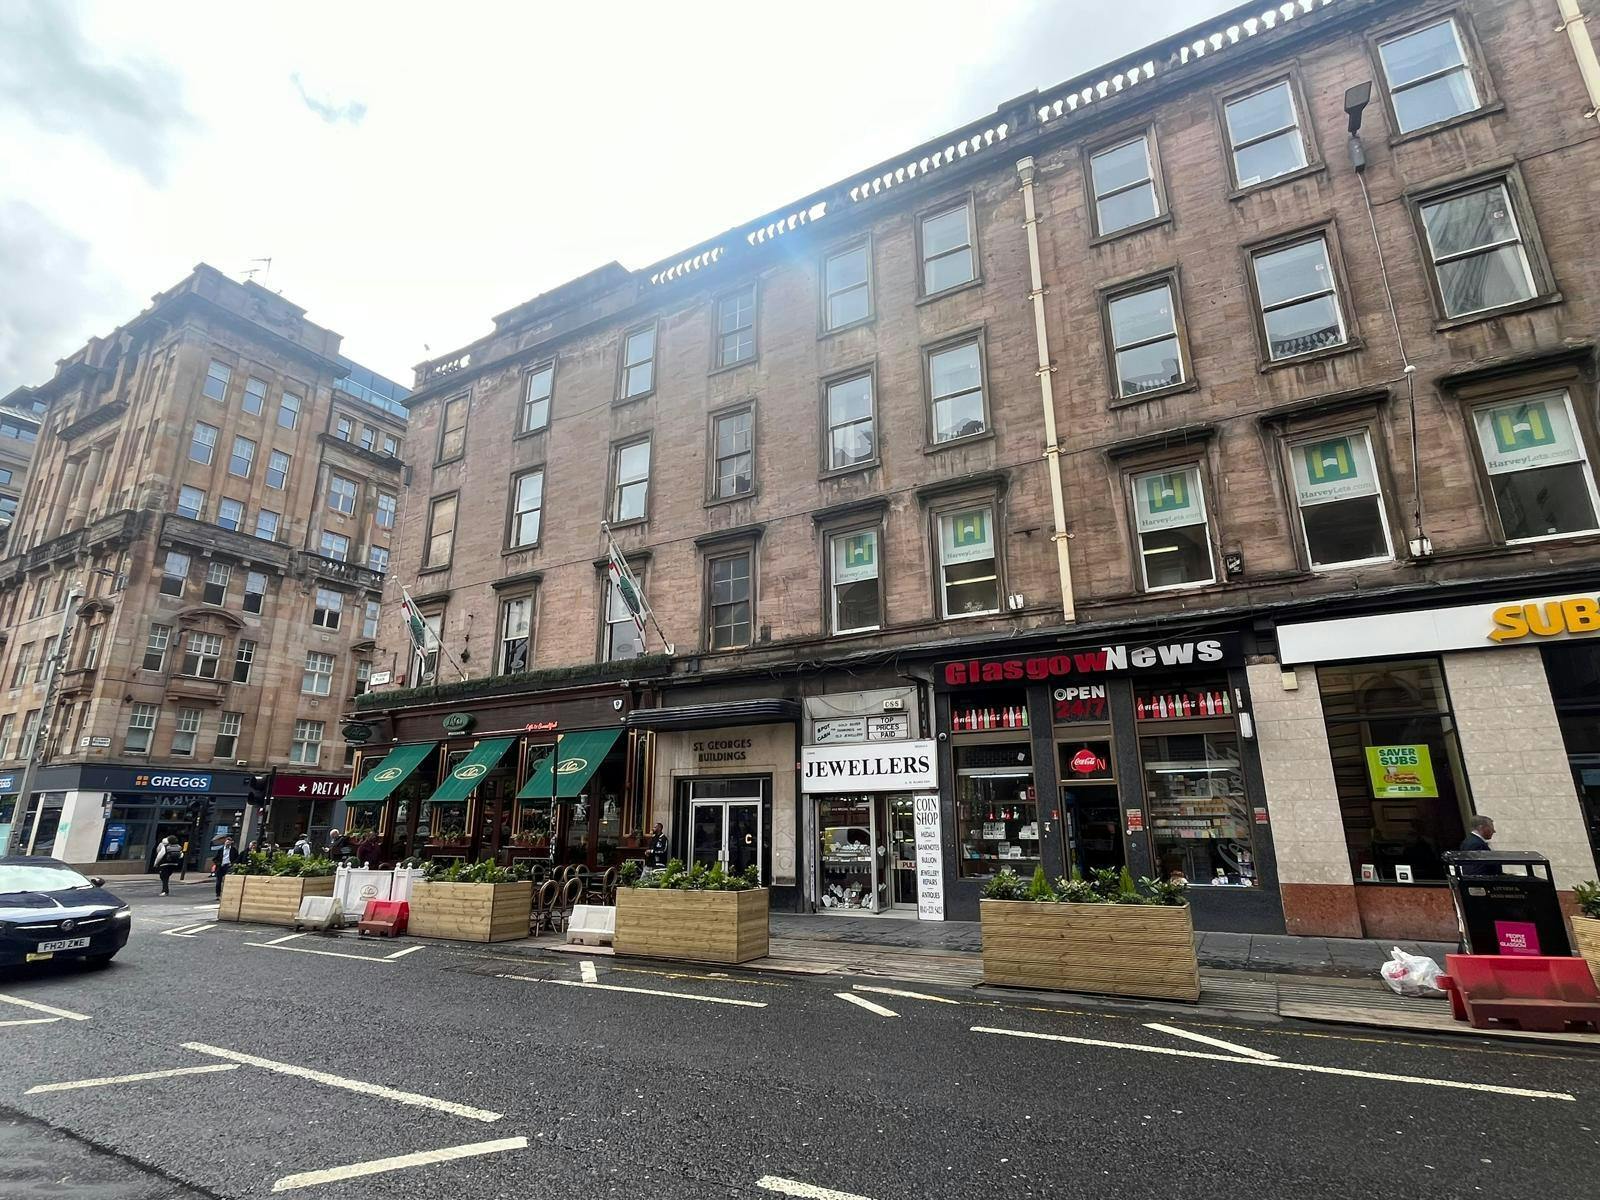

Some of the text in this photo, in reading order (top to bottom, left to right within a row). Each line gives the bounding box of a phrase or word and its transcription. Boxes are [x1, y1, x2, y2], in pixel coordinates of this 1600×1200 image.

[1486, 598, 1600, 643] SUB
[1101, 640, 1224, 671] News
[1054, 685, 1106, 701] OPEN
[1056, 700, 1106, 719] 24/7
[880, 716, 894, 724] TOP
[876, 723, 900, 731] PRICES
[707, 738, 752, 750] GEORGES
[698, 751, 747, 763] BUILDINGS
[1379, 748, 1416, 757] SAVER
[805, 755, 931, 778] JEWELLERS
[1380, 756, 1418, 766] SUBS
[150, 775, 208, 788] GREGGS
[311, 781, 334, 795] PRET
[333, 783, 340, 796] A
[916, 798, 937, 812] COIN
[916, 812, 938, 826] SHOP
[922, 878, 938, 886] REPAIRS
[921, 891, 941, 899] ANTIQUES
[43, 941, 66, 951] FH21
